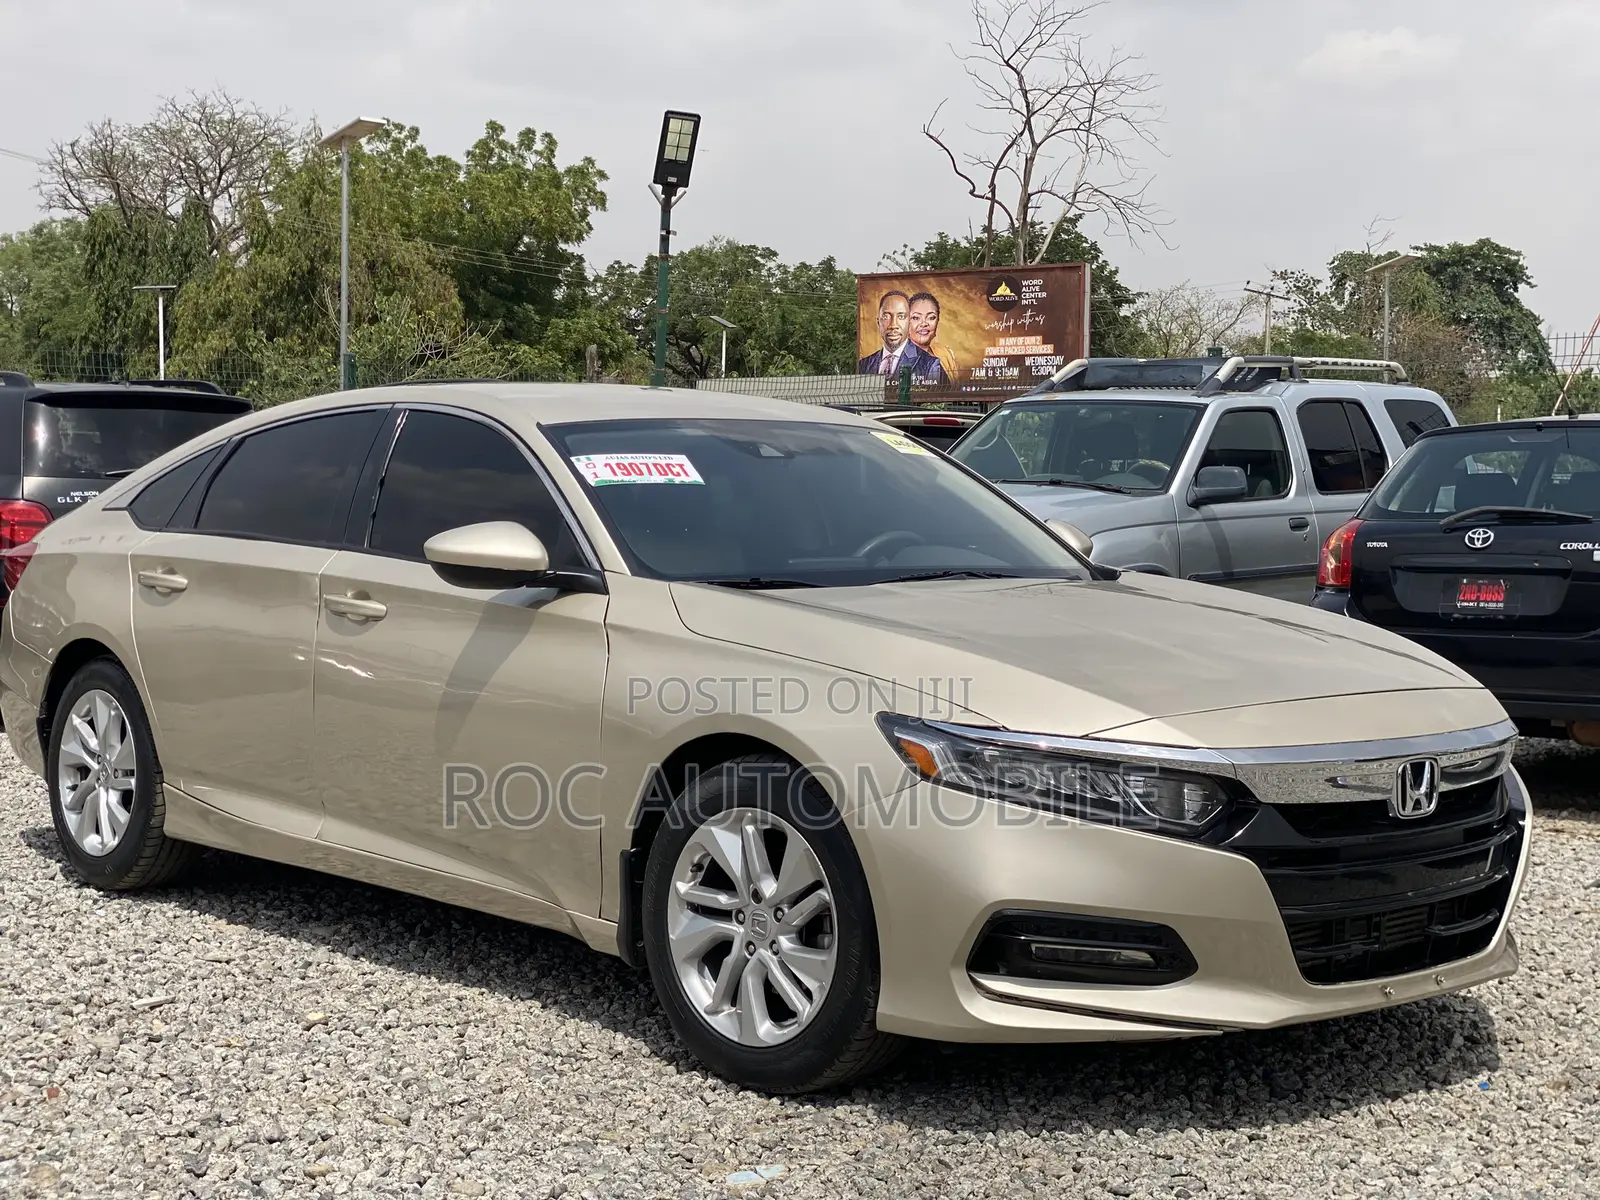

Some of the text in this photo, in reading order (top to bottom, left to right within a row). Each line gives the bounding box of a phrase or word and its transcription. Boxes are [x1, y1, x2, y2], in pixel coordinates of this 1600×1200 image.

[983, 355, 1064, 367] SUNDAY WEDNESDAY
[971, 368, 986, 377] 7AM
[988, 368, 993, 377] &
